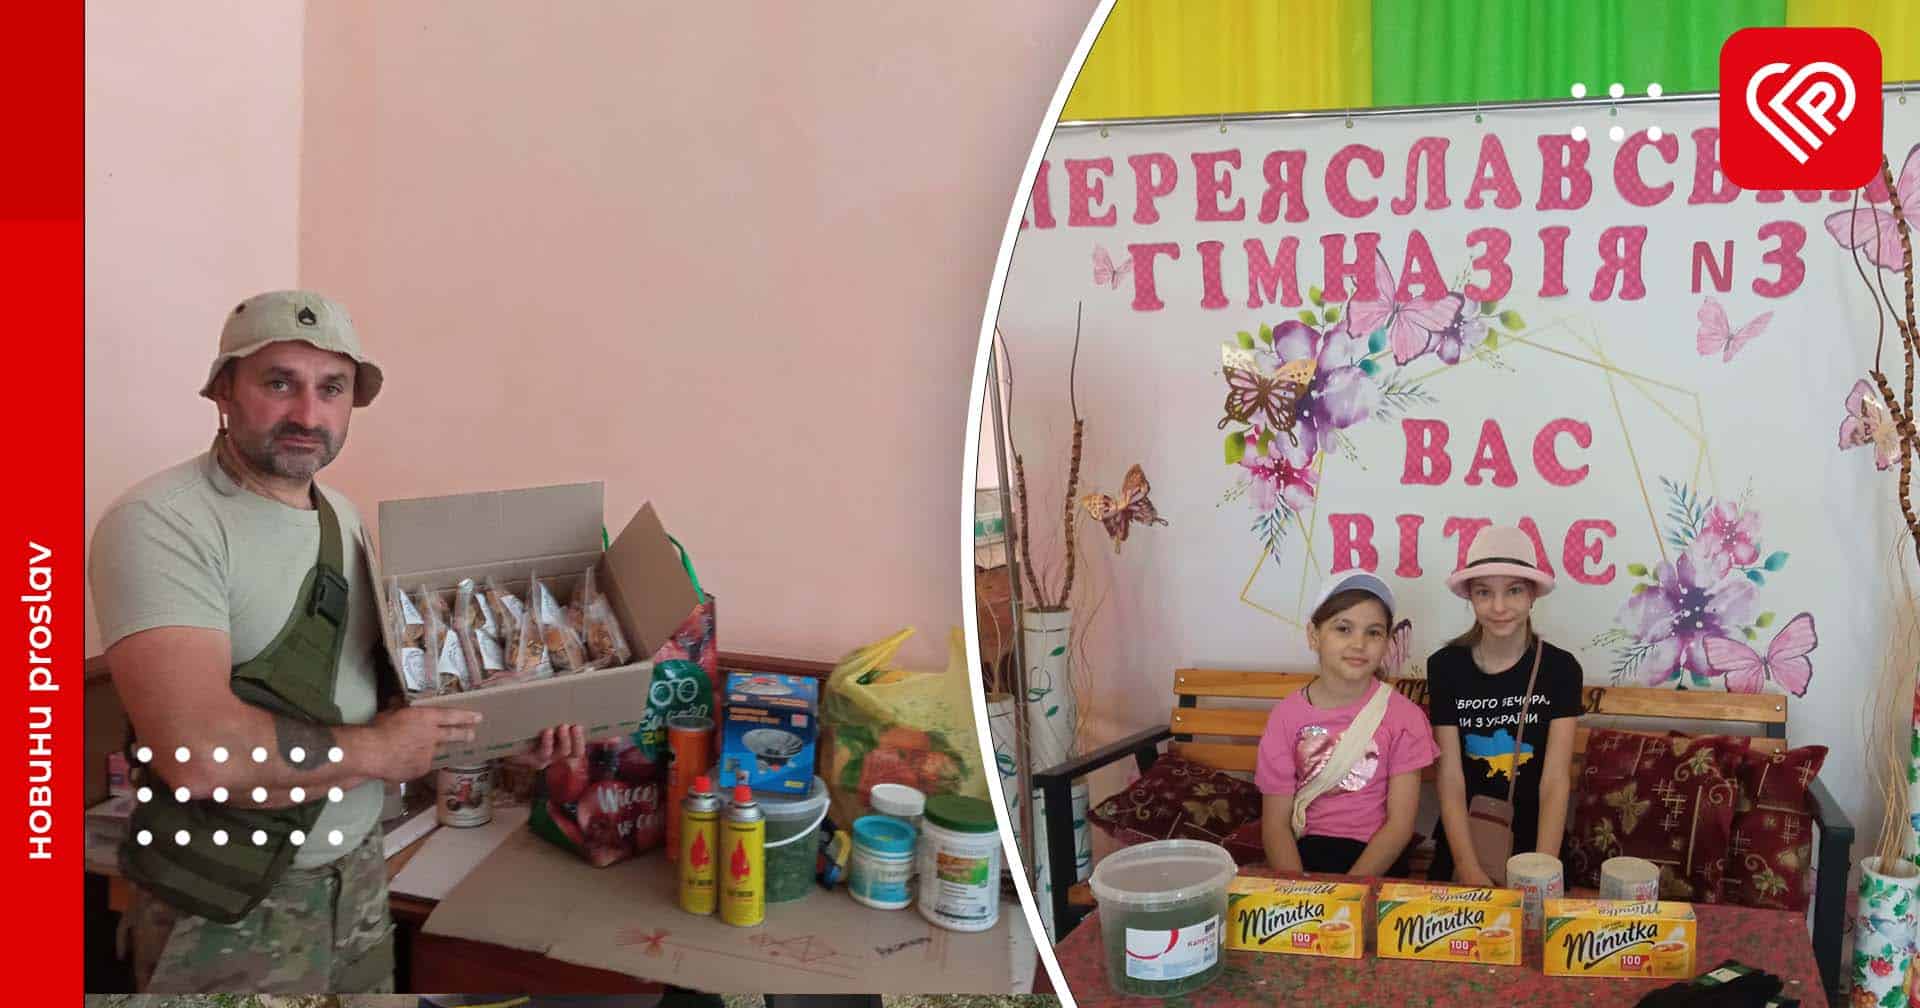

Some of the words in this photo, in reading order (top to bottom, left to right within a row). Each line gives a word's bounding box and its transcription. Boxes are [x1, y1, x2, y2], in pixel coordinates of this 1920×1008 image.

[1128, 226, 1648, 312] ГІМНАЗІЯ
[1752, 221, 1808, 298] 3
[1401, 418, 1592, 488] ВАС
[1239, 899, 1325, 944] Minutka
[1293, 932, 1310, 942] 100
[1394, 907, 1485, 953] Minutka
[1451, 940, 1469, 950] 100
[1562, 920, 1658, 970] Minutka
[1622, 955, 1641, 965] 100
